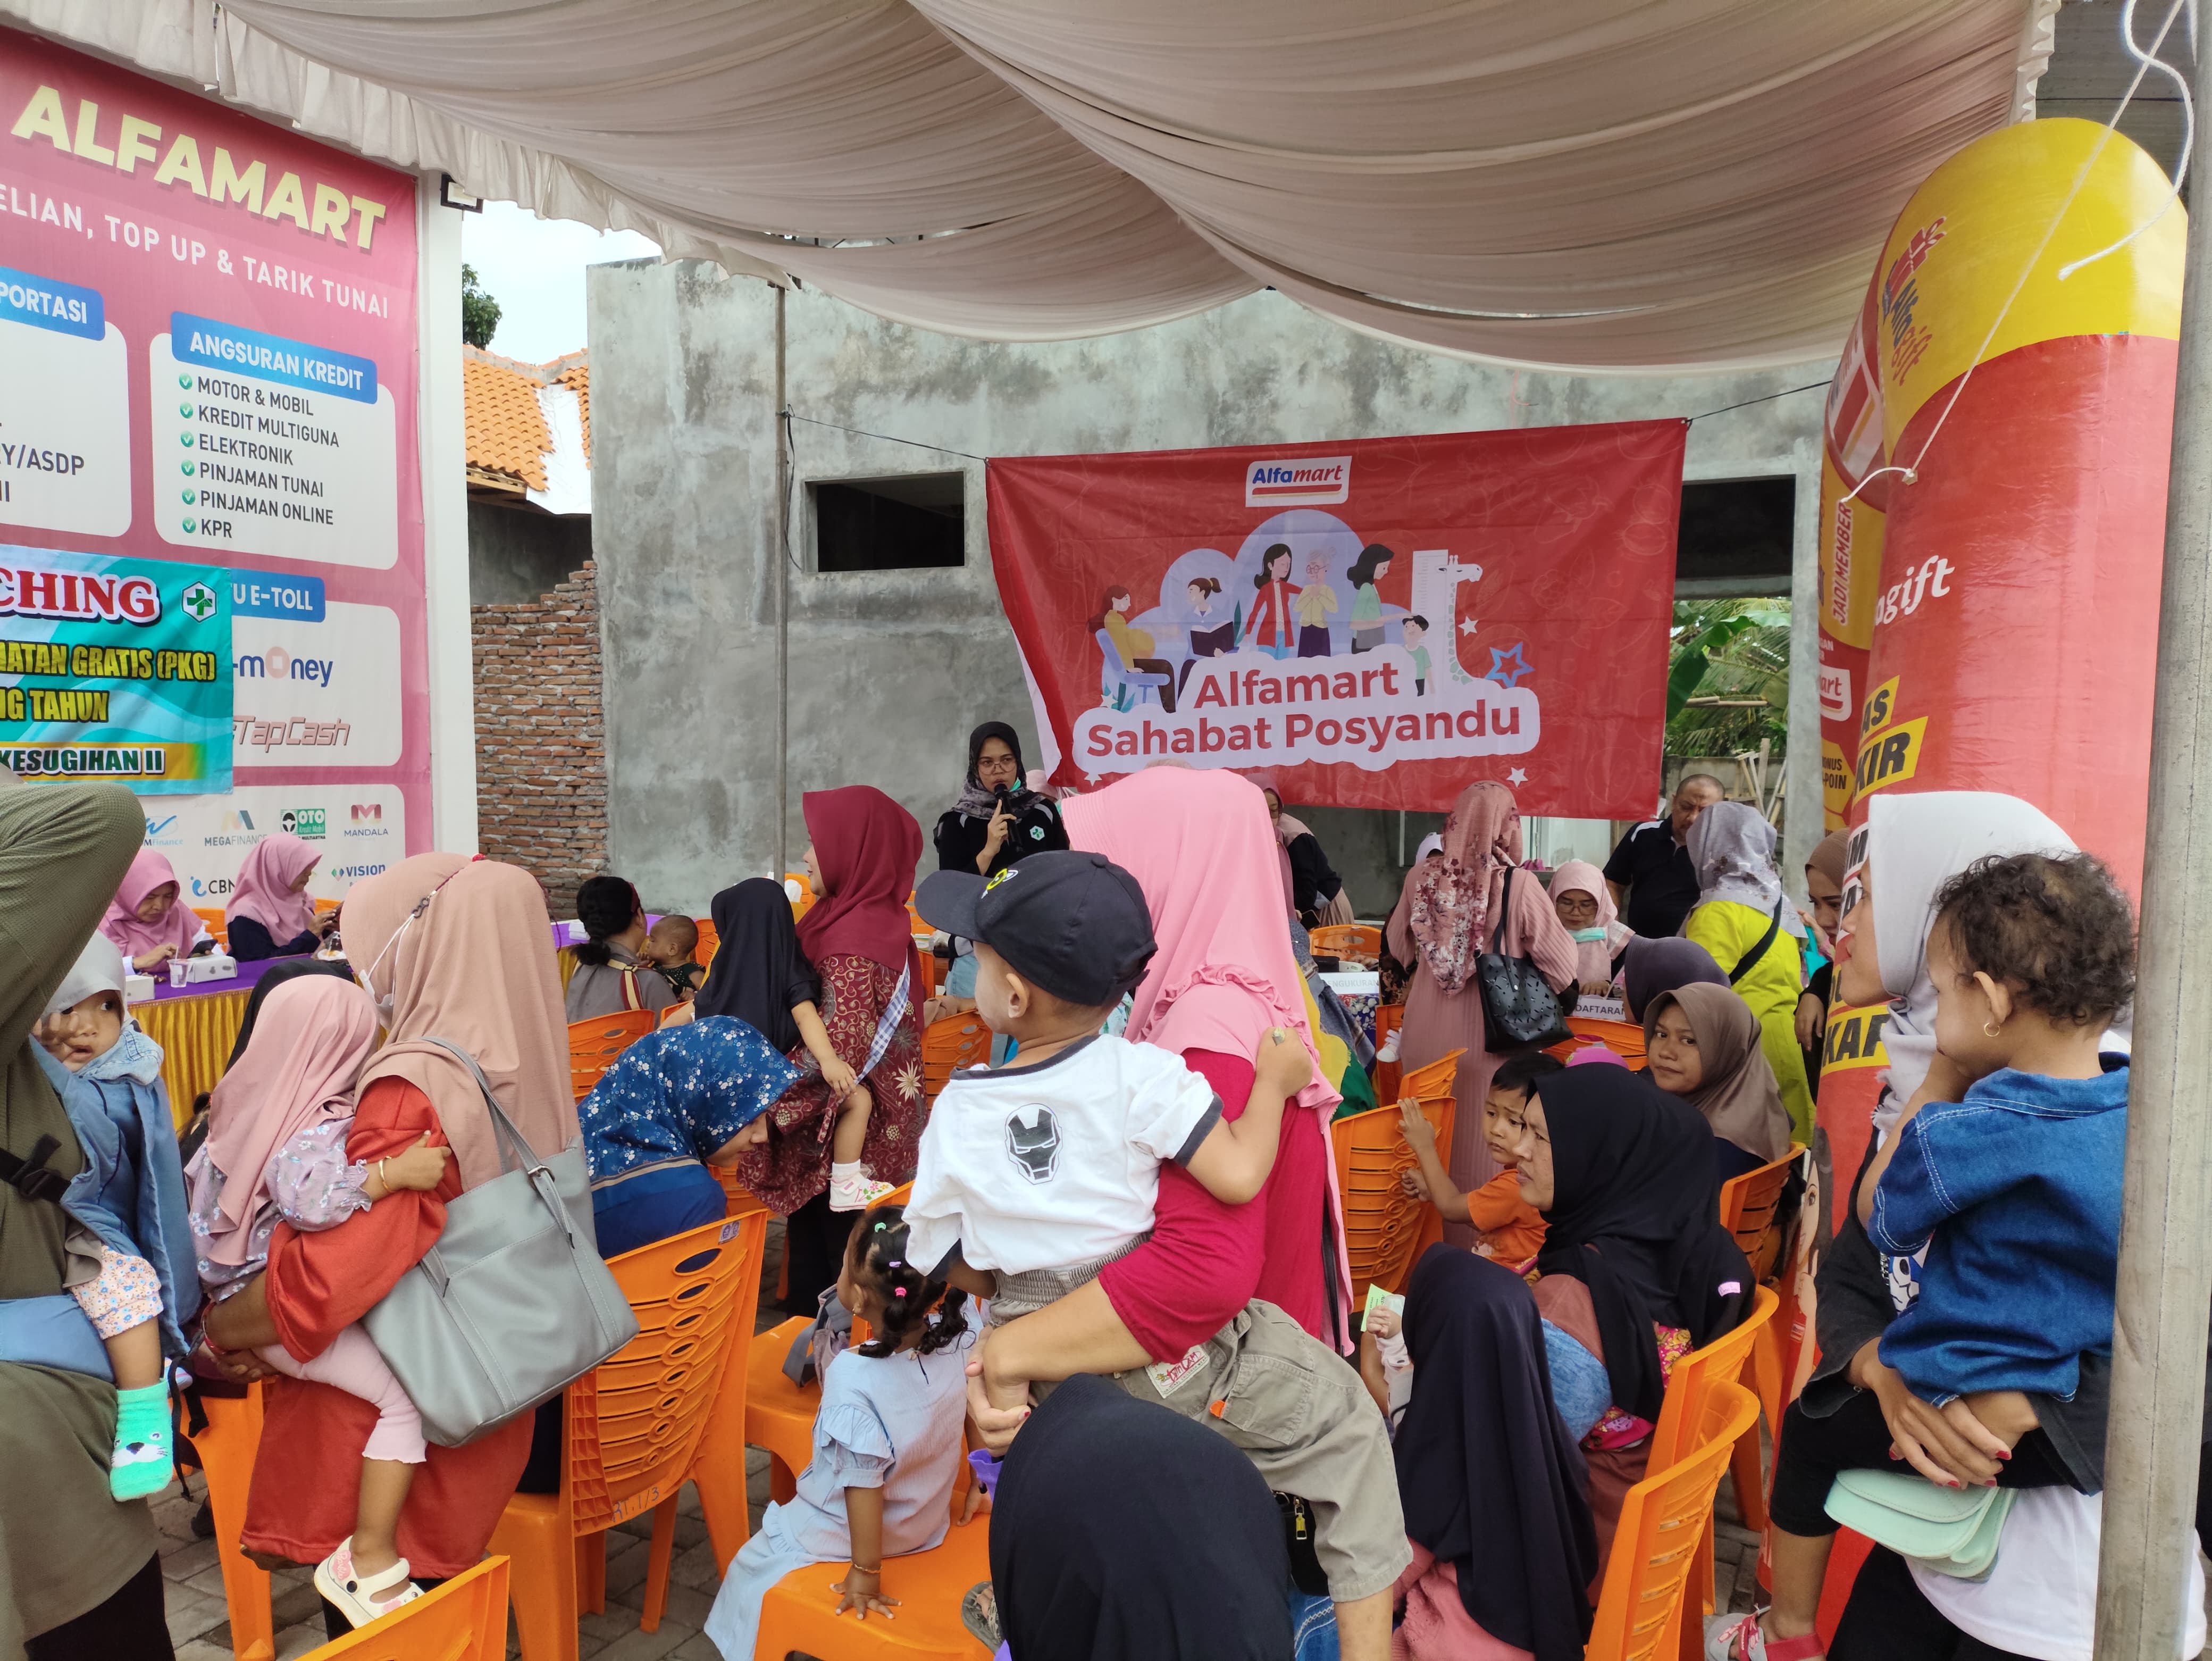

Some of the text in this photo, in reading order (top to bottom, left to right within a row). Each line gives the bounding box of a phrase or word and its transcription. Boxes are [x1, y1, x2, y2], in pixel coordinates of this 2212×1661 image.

[11, 85, 386, 249] ALFAMART
[105, 214, 160, 252] TOP
[171, 234, 206, 265] UP
[217, 250, 234, 276] &
[243, 256, 314, 298] TARIK
[322, 279, 388, 319] TUNAI
[0, 282, 87, 323] PORTASI
[190, 331, 363, 390] ANGSURAN KREDIT
[198, 376, 314, 416] MOTOR & MOBIL
[198, 404, 339, 447] KREDIT MULTIGUNA
[0, 443, 84, 475] Y/ASDP
[199, 433, 294, 465] ELEKTRONIK
[200, 462, 323, 497] PINJAMAN TUNAI
[1252, 465, 1343, 484] Alfamart
[200, 490, 333, 525] PINJAMAN ONLINE
[201, 519, 232, 538] KPR
[1833, 502, 1851, 624] JADI MEMBER
[251, 585, 313, 611] E-TOLL
[72, 647, 152, 678] GRATIS
[158, 652, 215, 680] (PKG)
[1194, 662, 1398, 709] Alfamart
[1820, 675, 1842, 696] art
[30, 690, 108, 721] TAHUN
[1087, 700, 1520, 756] Sahabat Posyandu
[146, 750, 162, 771] II
[298, 810, 324, 824] OTO
[344, 828, 389, 837] MANDALA
